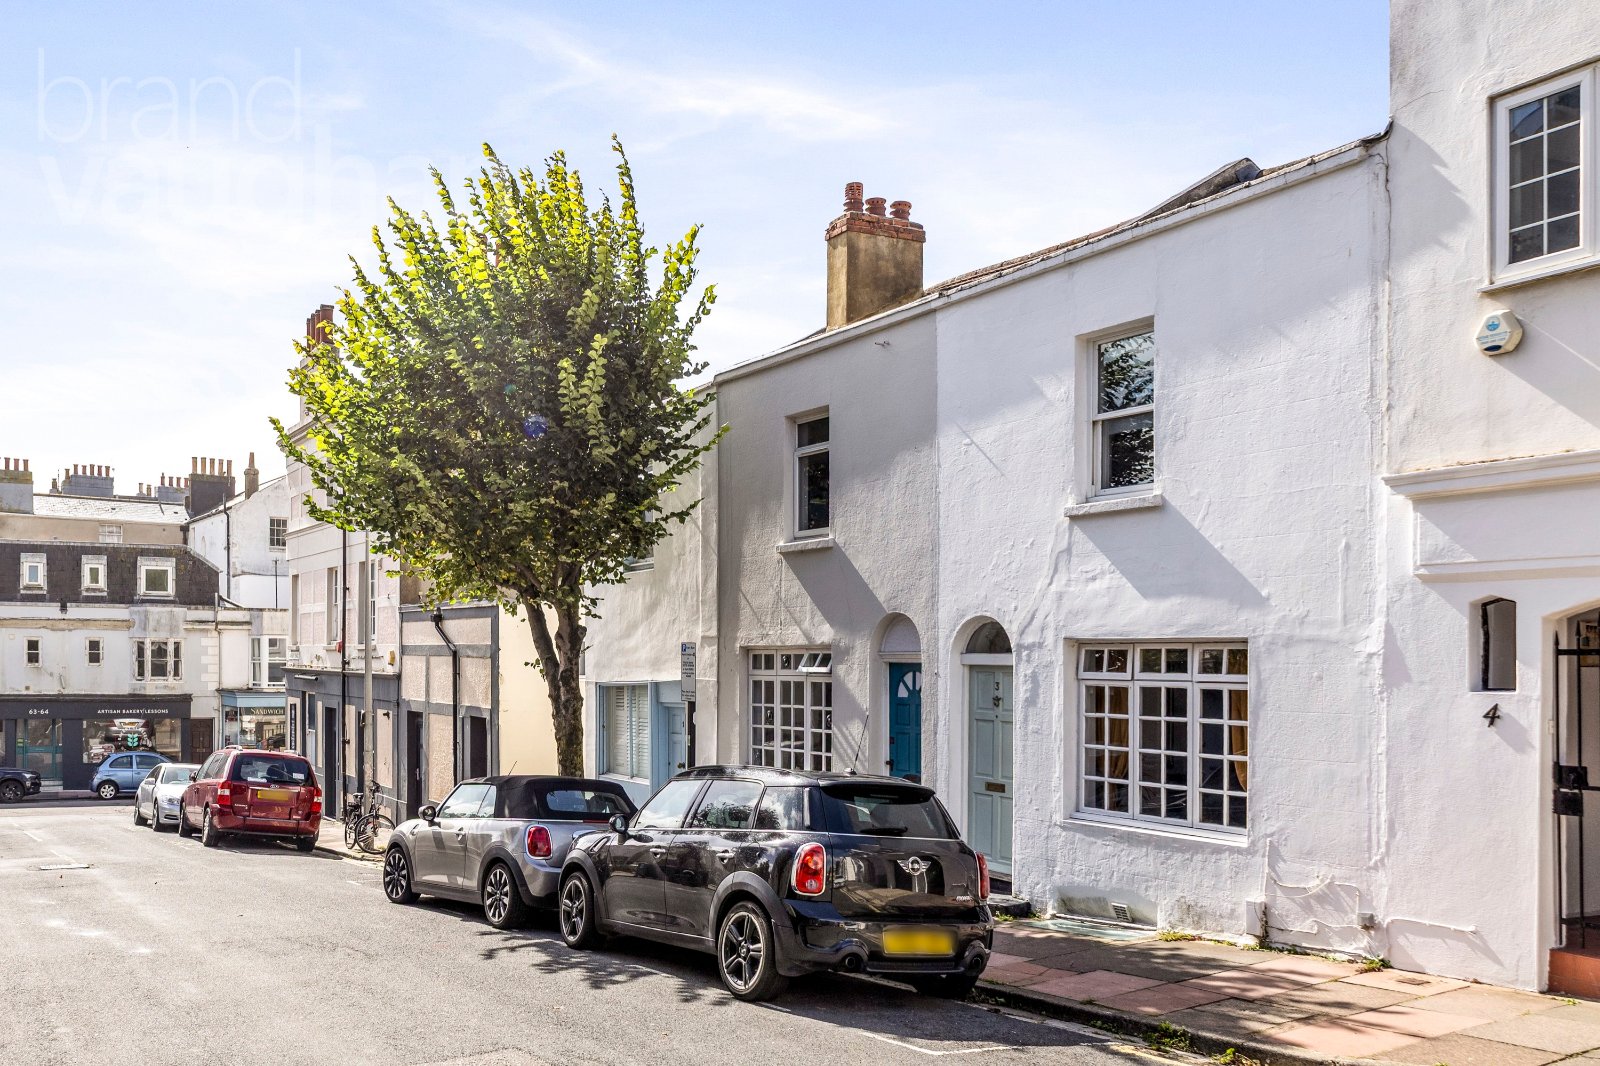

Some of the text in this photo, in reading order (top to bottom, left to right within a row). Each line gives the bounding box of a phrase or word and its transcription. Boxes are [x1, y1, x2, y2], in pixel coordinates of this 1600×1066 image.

[994, 681, 1000, 691] 3
[250, 707, 284, 715] SANDWICH
[1482, 703, 1501, 728] 4
